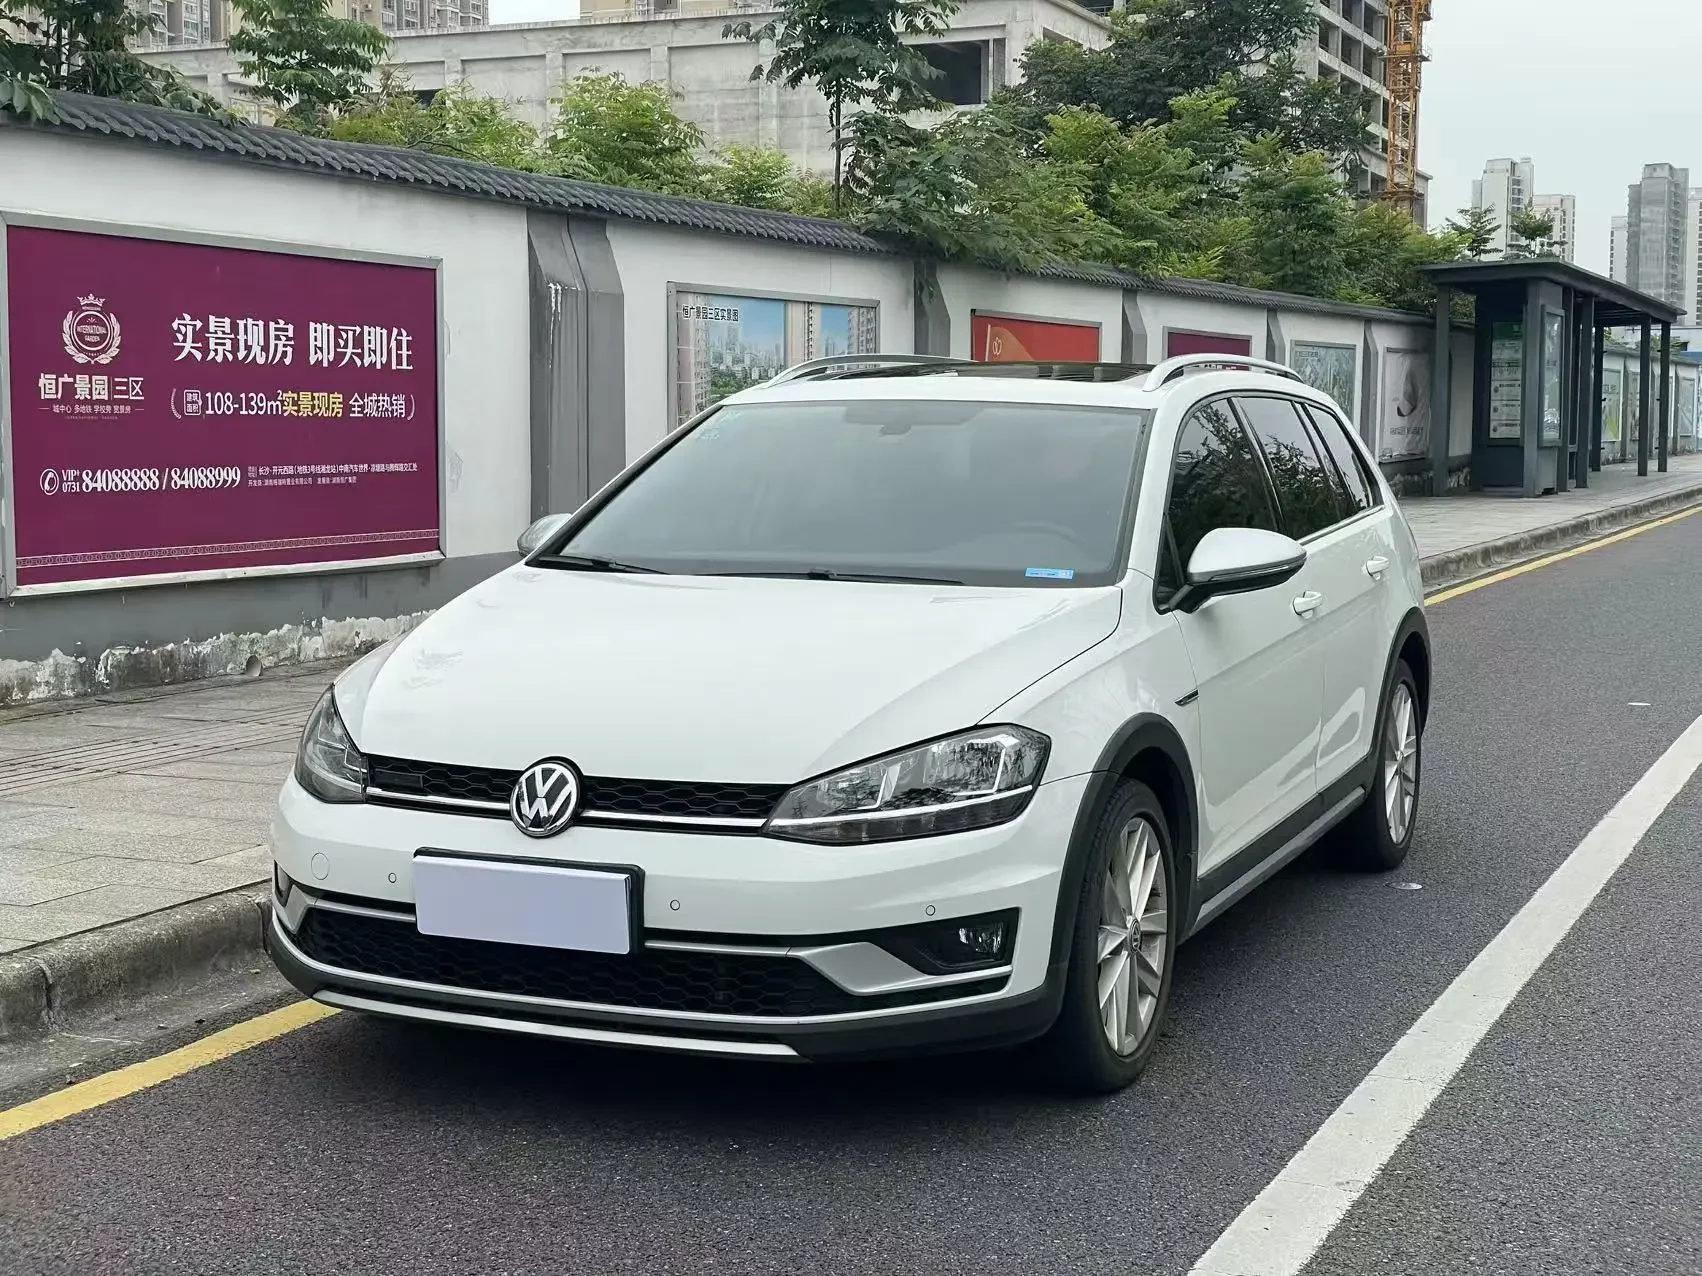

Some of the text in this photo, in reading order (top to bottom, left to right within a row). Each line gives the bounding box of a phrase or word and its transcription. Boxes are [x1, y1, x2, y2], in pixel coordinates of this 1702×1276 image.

[682, 304, 739, 321] 恒广景园三区实景图
[171, 313, 414, 370] 实景现房 即买即住
[349, 393, 406, 418] 全城热销
[62, 482, 80, 493] 0731
[82, 468, 160, 493] 84088888
[170, 466, 241, 489] 84088999
